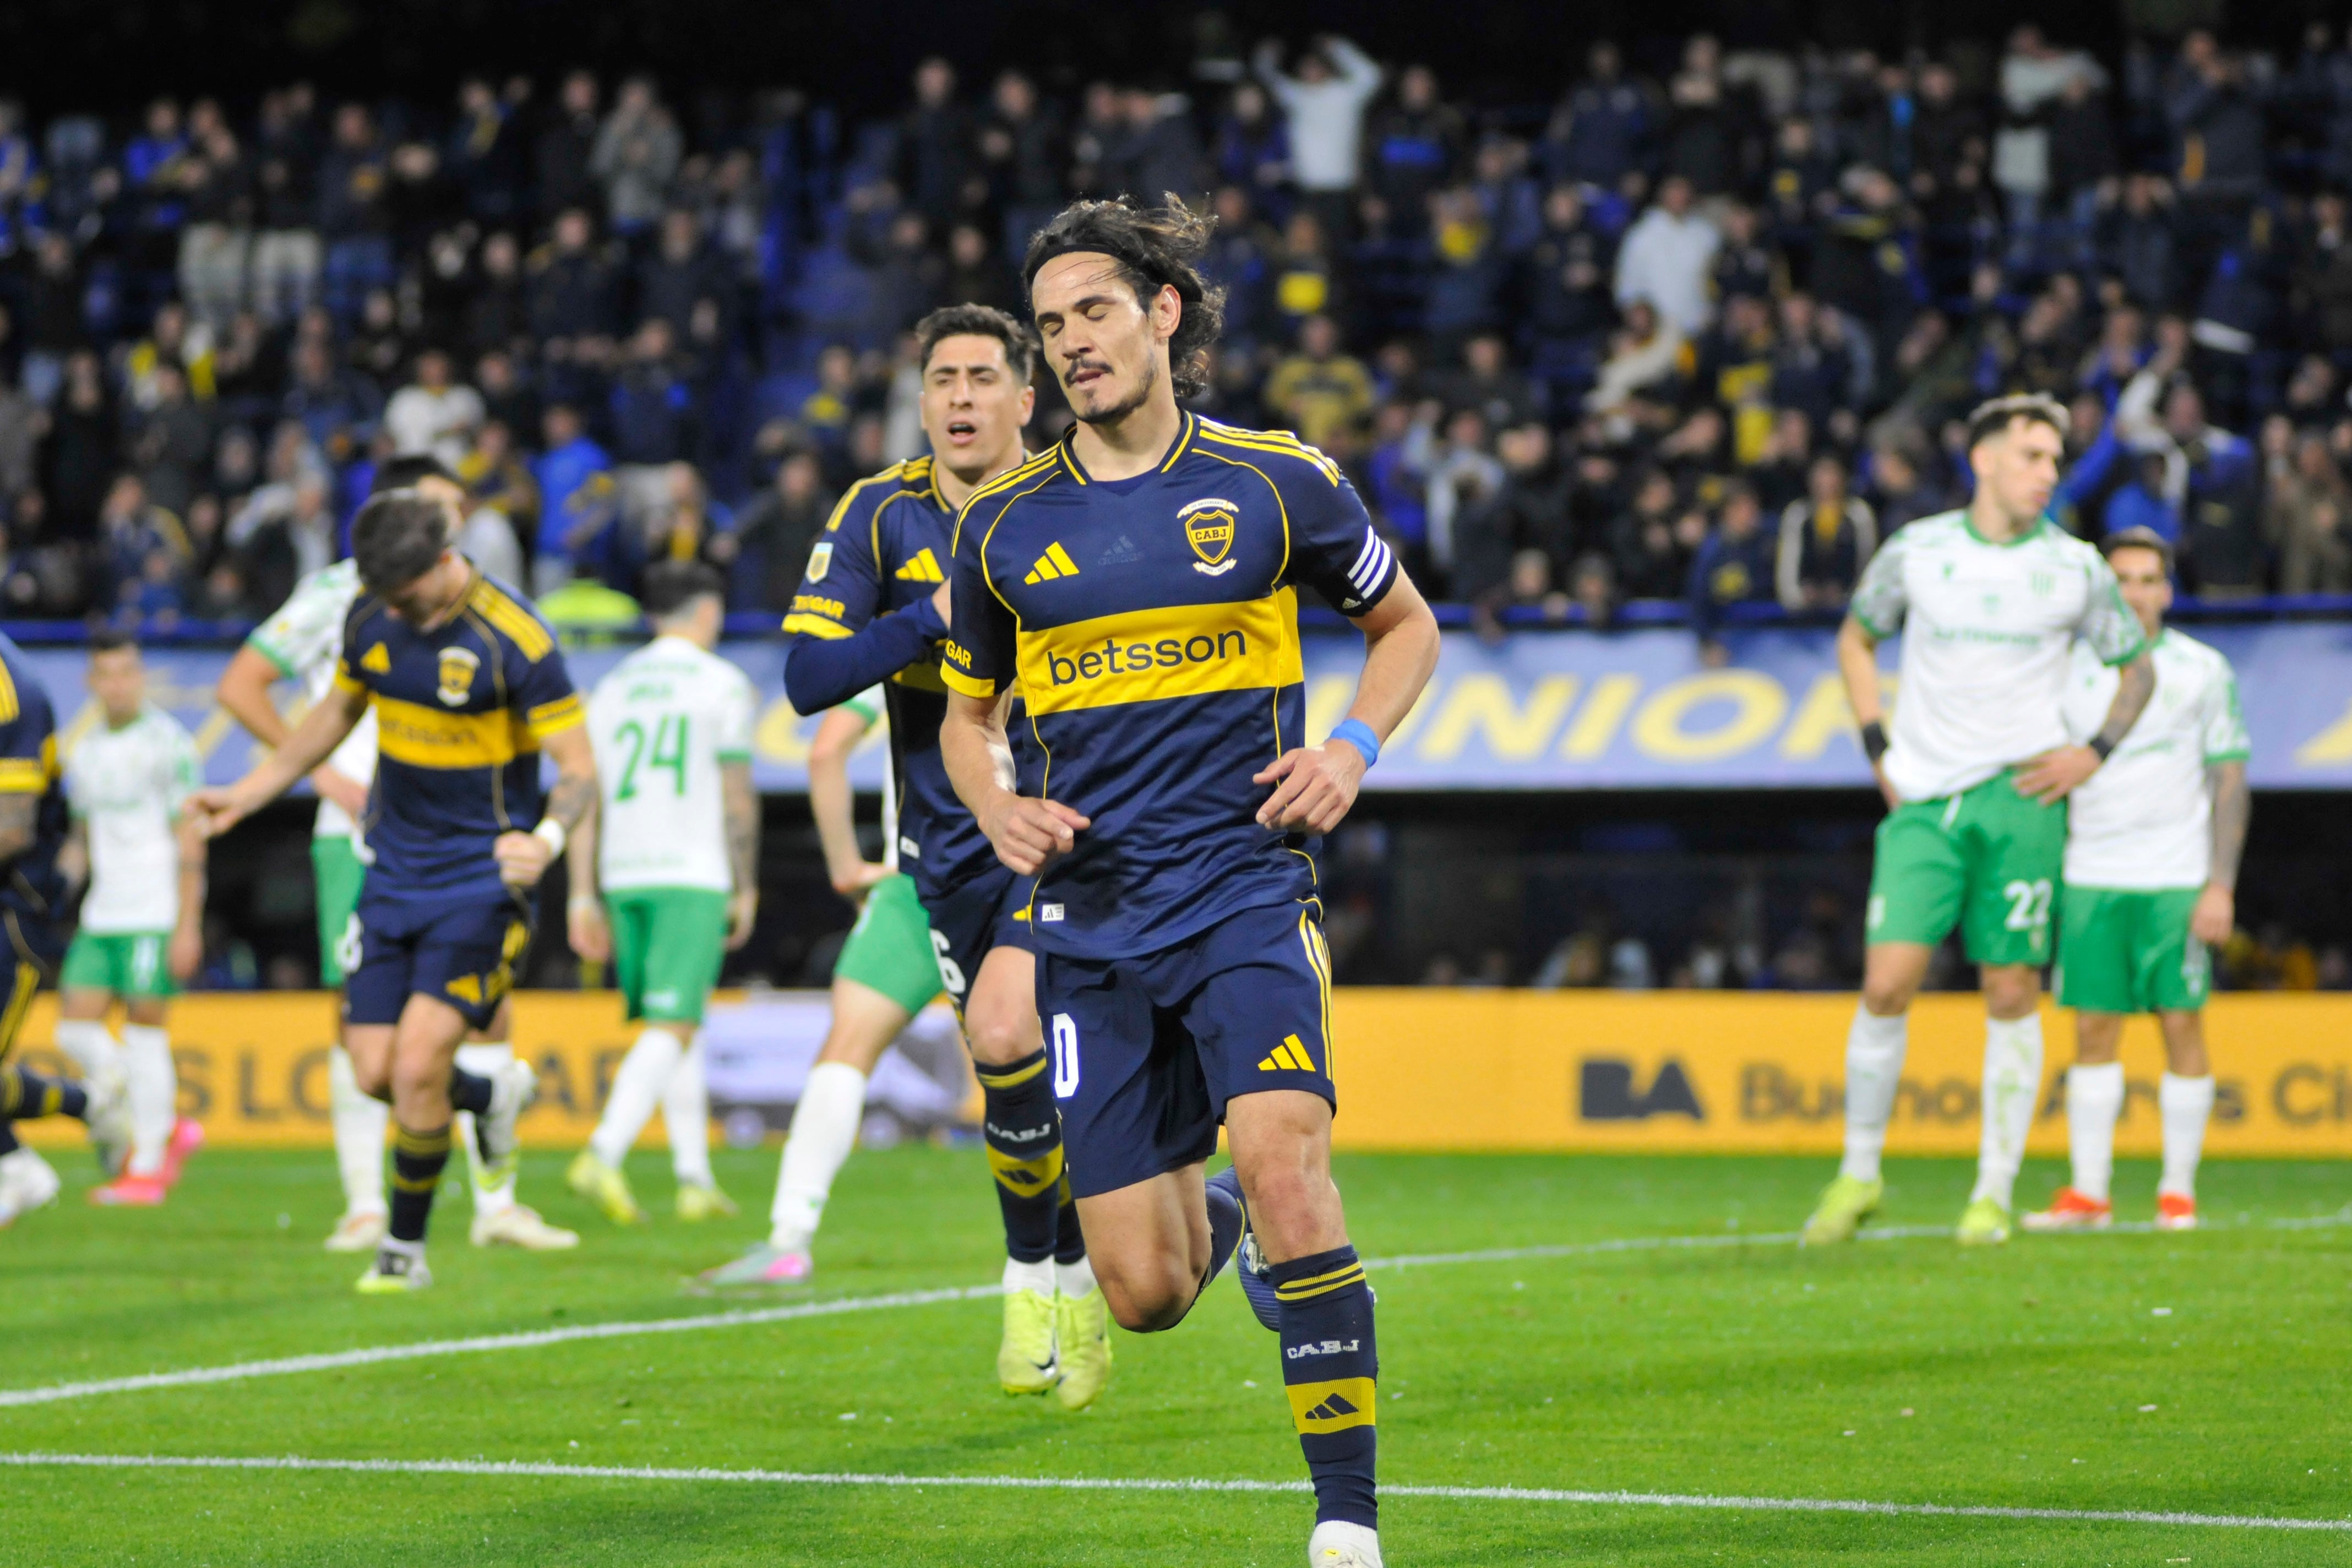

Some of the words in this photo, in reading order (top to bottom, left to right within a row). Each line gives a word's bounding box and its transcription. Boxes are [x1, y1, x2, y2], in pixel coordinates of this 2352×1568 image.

[1195, 529, 1226, 540] CABJ
[1047, 629, 1246, 686] betsson
[613, 714, 688, 802] 24
[1287, 1339, 1359, 1359] CABJ
